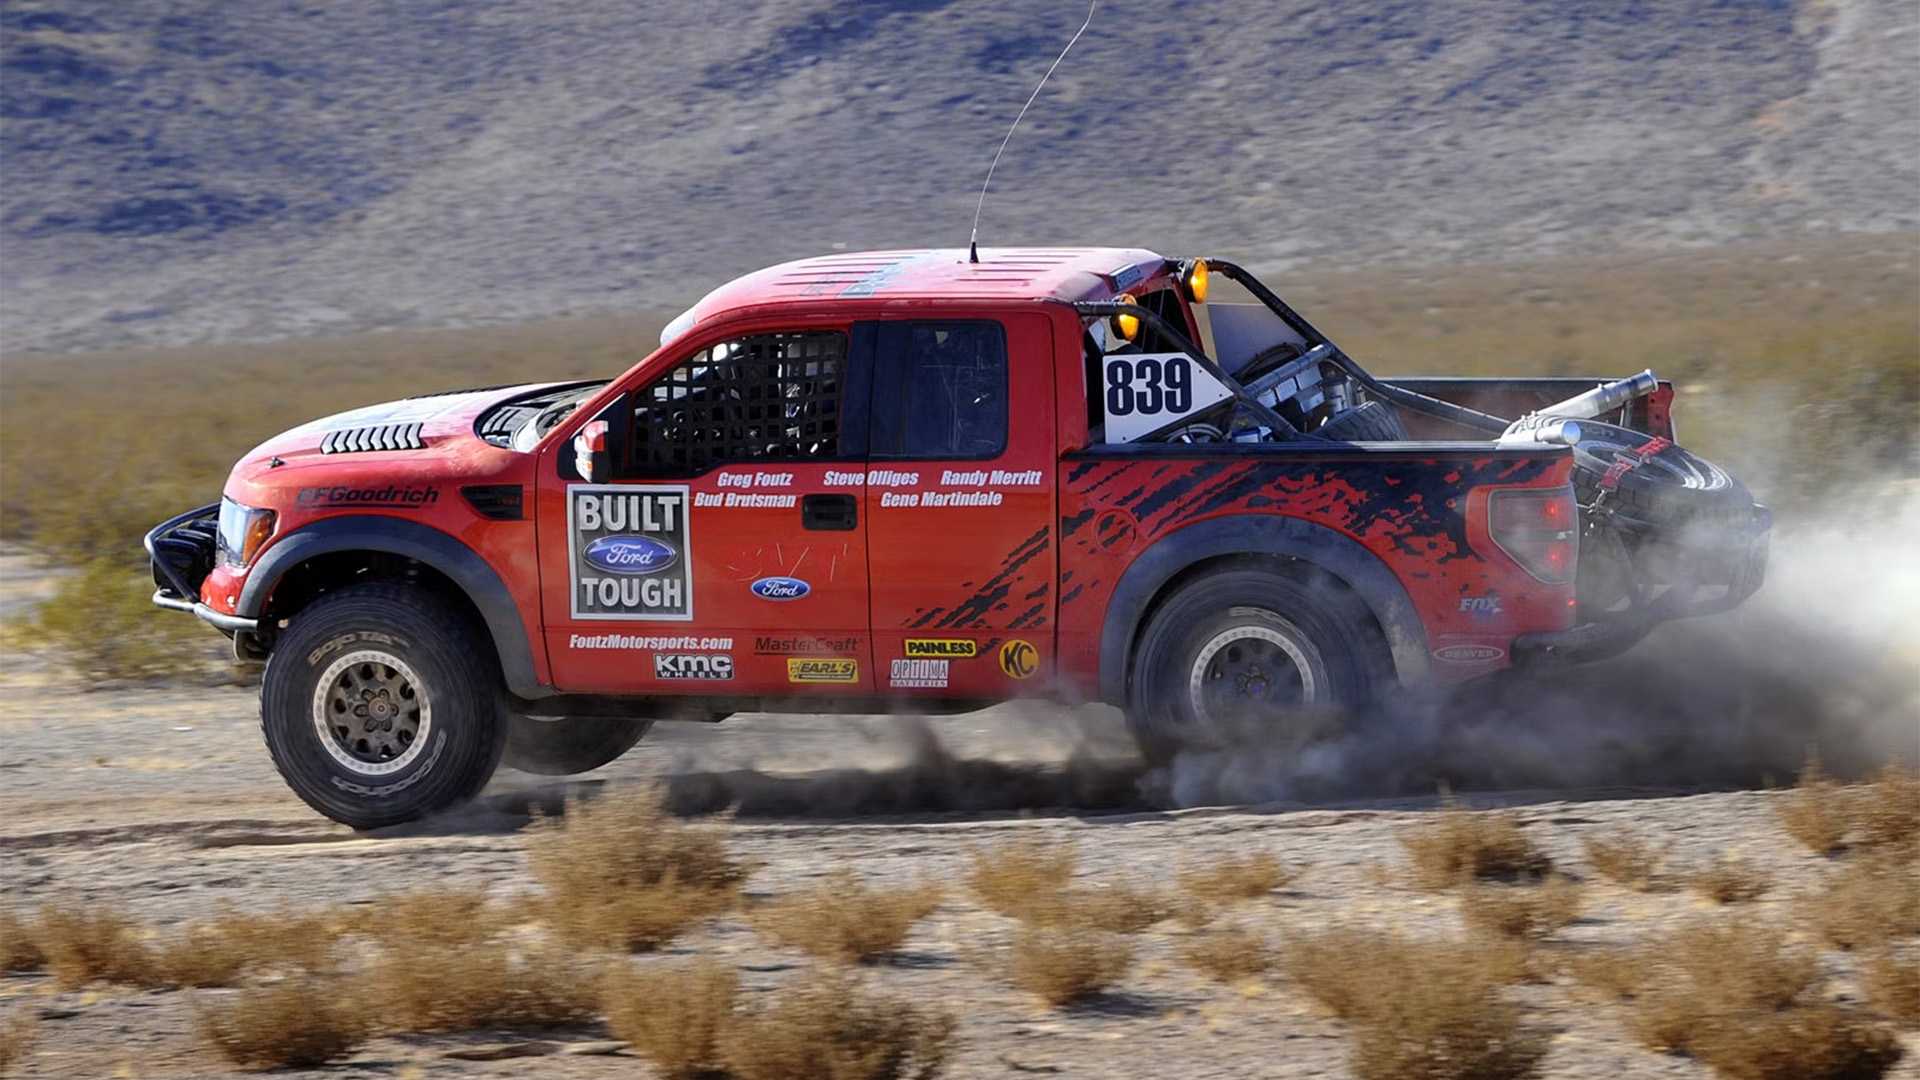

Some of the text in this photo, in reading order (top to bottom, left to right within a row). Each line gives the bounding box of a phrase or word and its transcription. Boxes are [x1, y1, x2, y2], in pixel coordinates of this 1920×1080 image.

[1106, 357, 1193, 416] 839
[717, 472, 793, 488] Greg Foutz
[823, 470, 919, 487] Steve Olliges
[940, 470, 1042, 487] Randy Merritt
[694, 492, 797, 508] Bud Brutsman
[880, 491, 1003, 507] Gene Martindale
[579, 494, 681, 531] BUILT
[606, 543, 654, 564] Ford
[581, 577, 682, 608] TOUGH
[762, 580, 799, 596] Ford
[569, 634, 733, 650] FoutzMotorsports.com
[907, 642, 974, 654] PAINLESS
[799, 662, 851, 673] EARL'S
[1003, 642, 1035, 677] KC
[891, 660, 948, 678] OPTIMA
